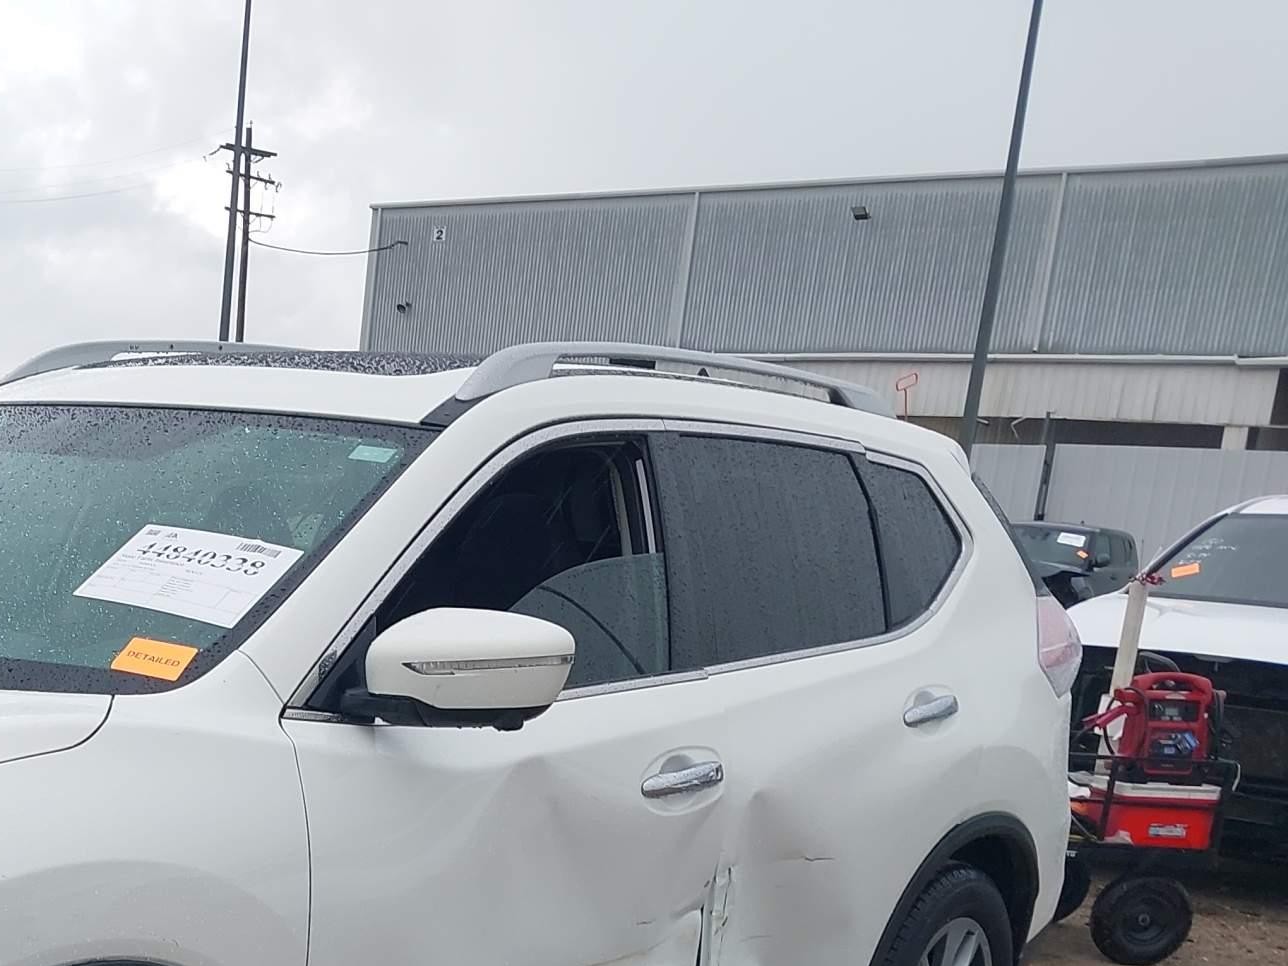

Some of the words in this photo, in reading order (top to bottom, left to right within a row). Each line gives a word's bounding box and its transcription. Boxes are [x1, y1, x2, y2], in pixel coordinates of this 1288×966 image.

[435, 229, 444, 240] 2
[136, 541, 266, 576] 44840338
[126, 650, 181, 667] DETAILED
